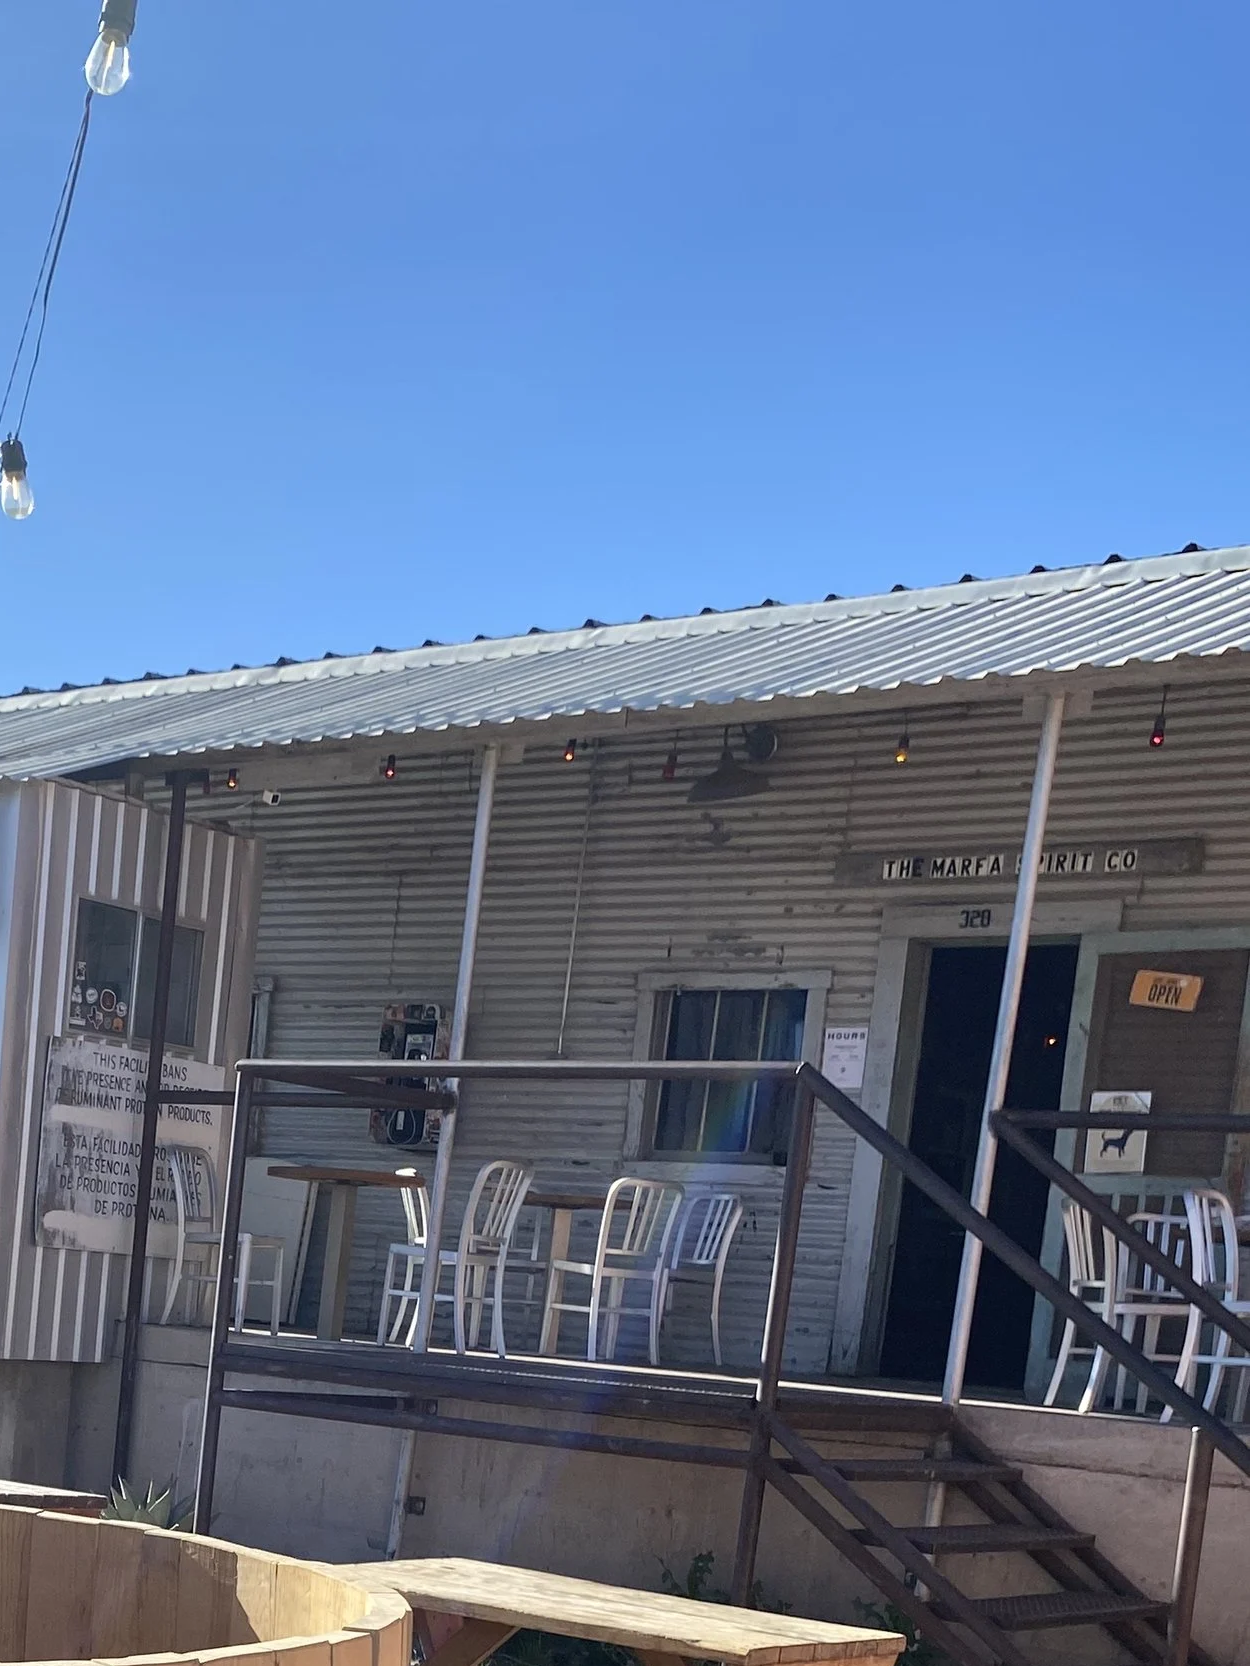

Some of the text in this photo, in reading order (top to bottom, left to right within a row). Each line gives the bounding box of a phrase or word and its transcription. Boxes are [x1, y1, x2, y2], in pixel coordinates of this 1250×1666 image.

[887, 856, 924, 878] THE
[931, 856, 1001, 877] MARFA
[1107, 850, 1136, 870] CO
[1148, 984, 1183, 1006] OPEN
[827, 1031, 866, 1041] HOURS
[93, 1051, 188, 1082] THIS FACILI BANS
[86, 1070, 132, 1093] PRESENCE
[71, 1089, 122, 1112] RUMINANT
[63, 1134, 87, 1150] ESTA
[93, 1135, 142, 1158] FACILIDAD
[55, 1153, 69, 1169] LA
[74, 1155, 130, 1177] PRESENCIA
[60, 1176, 72, 1190] DE
[76, 1177, 136, 1198] PRODUCTOS
[94, 1200, 107, 1216] DE
